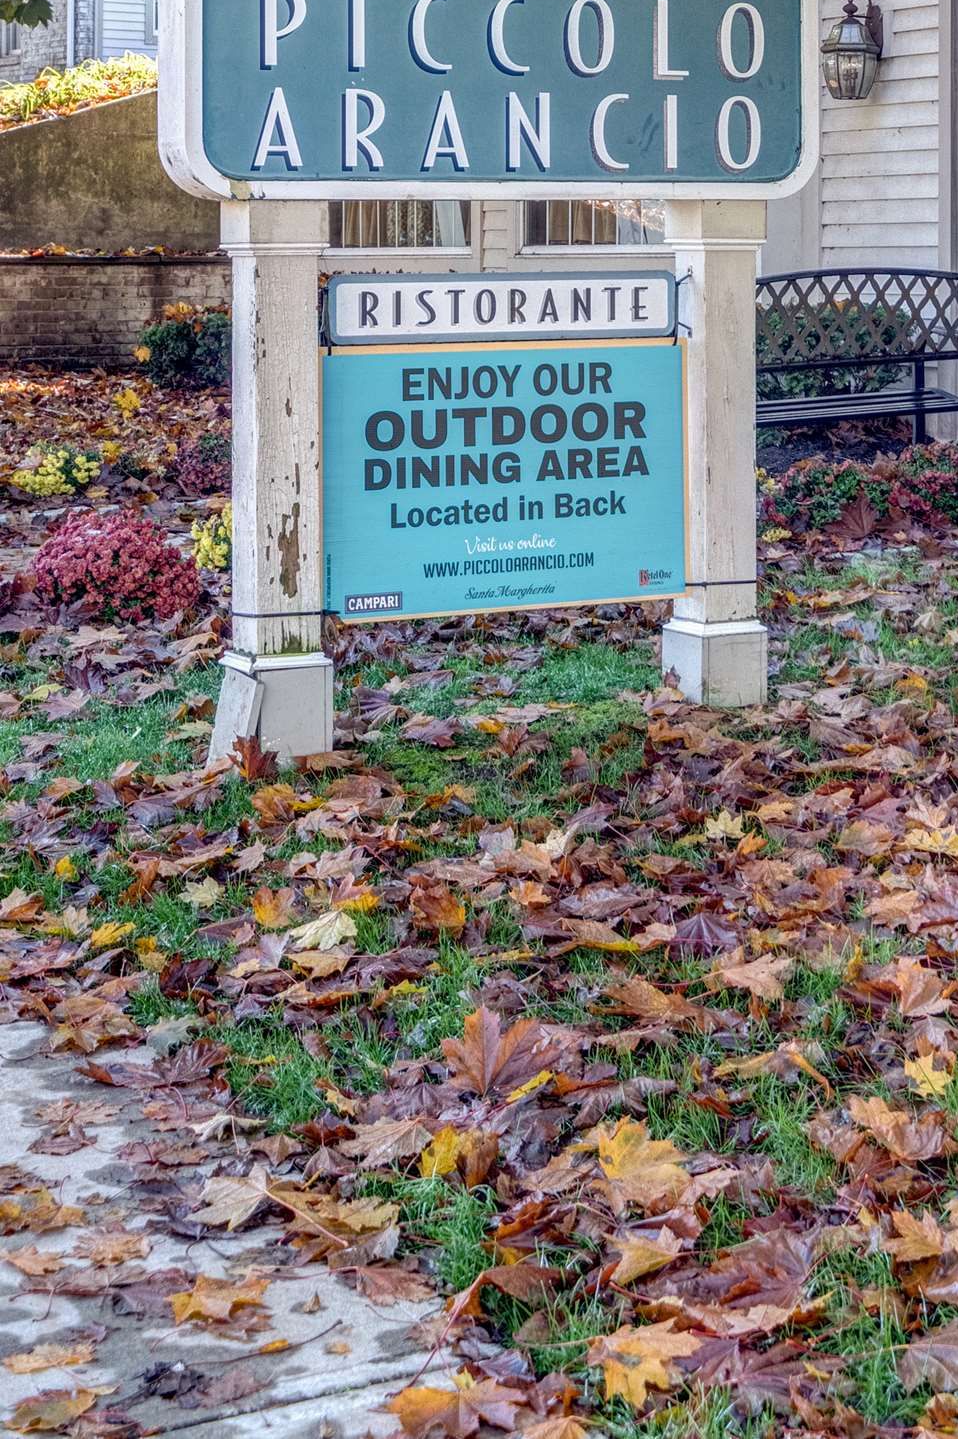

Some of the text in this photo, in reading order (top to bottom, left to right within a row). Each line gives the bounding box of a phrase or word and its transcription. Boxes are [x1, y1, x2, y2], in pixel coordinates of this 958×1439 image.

[252, 86, 762, 172] ARANCIO
[358, 286, 650, 328] RISTORANTE
[401, 361, 612, 402] ENJOY OUR
[364, 401, 647, 452] OUTDOOR
[363, 445, 649, 491] DINING AREA
[390, 490, 627, 529] Located in Back
[464, 533, 557, 555] Visit us online
[423, 551, 595, 579] WWW.PICCOLOARANCIO.COM
[348, 595, 399, 611] CAMPARI
[464, 583, 556, 601] Santa Margherita
